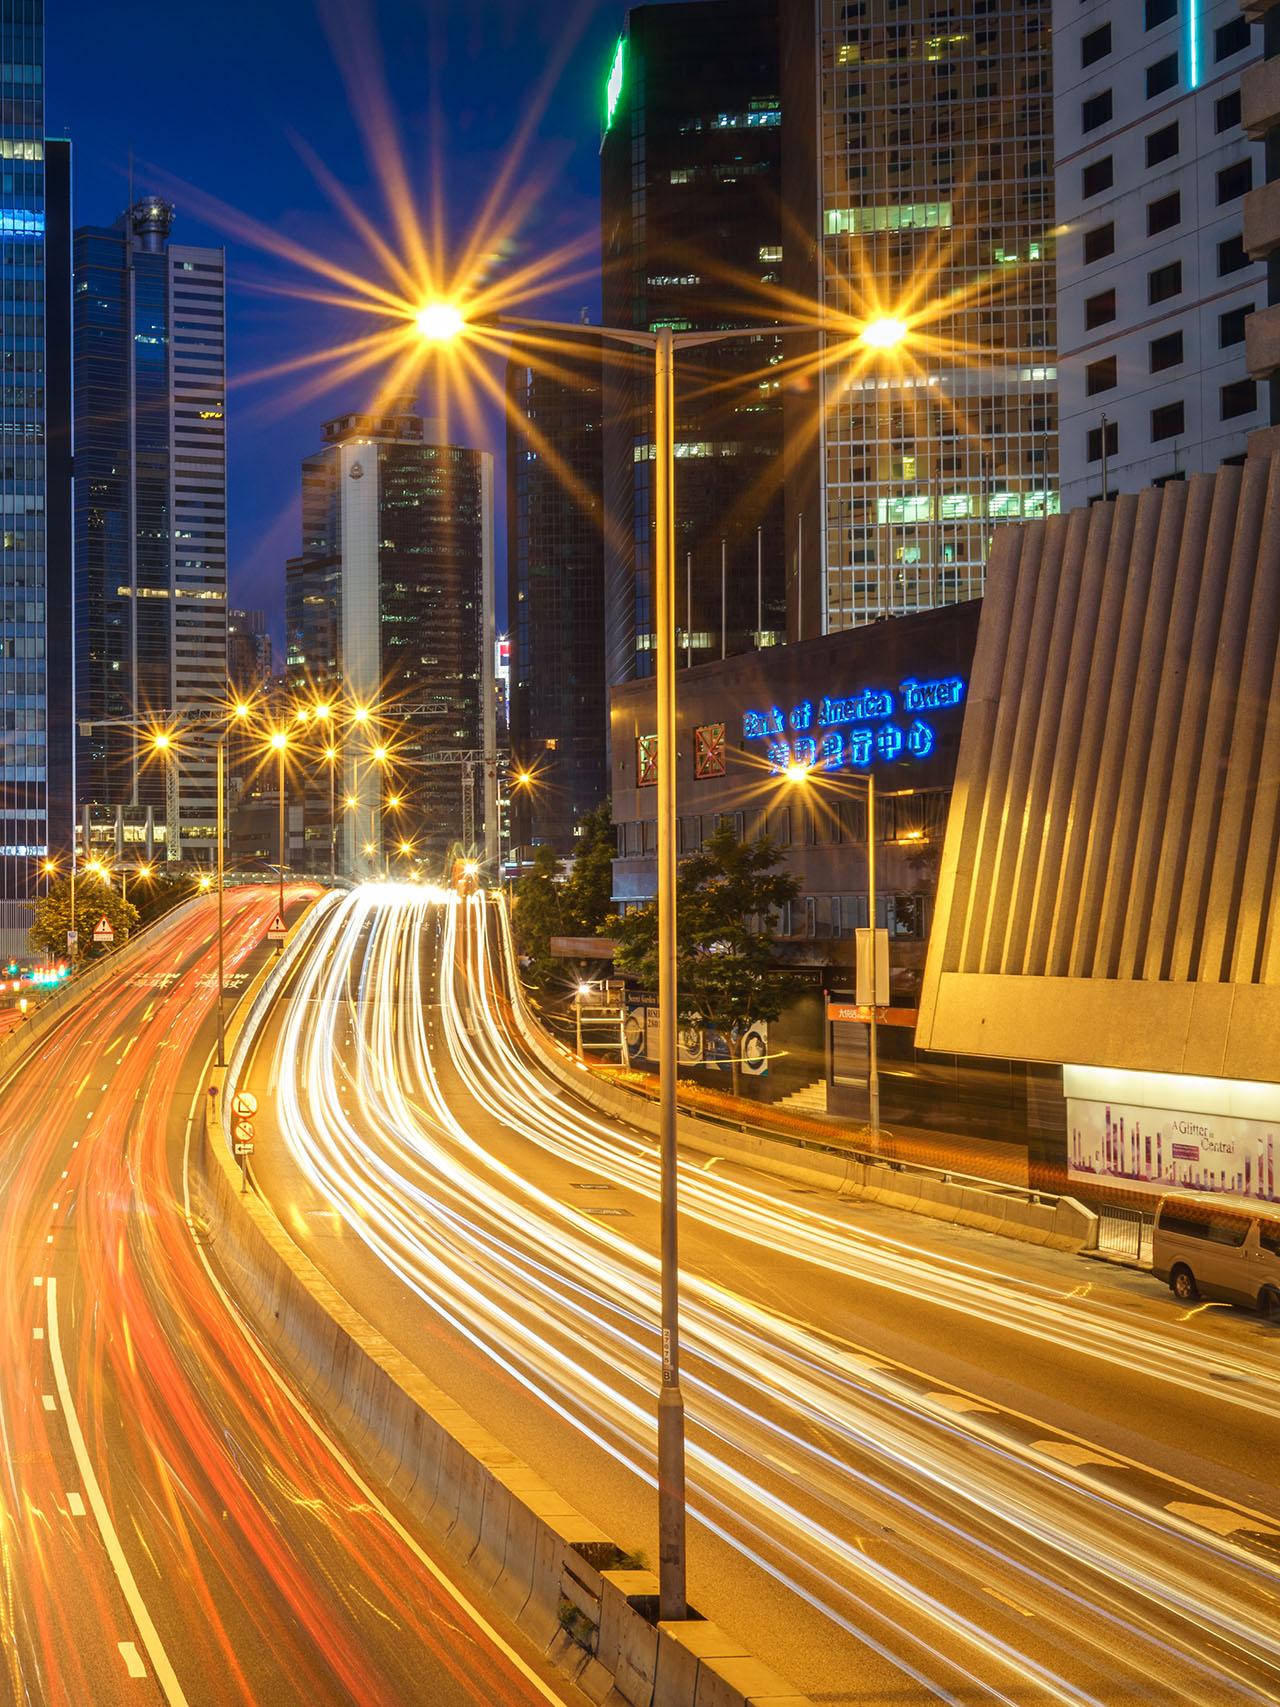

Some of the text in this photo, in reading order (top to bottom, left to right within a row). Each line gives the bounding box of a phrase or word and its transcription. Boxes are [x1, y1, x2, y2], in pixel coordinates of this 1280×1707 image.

[742, 679, 963, 738] Bank of America Tower
[1179, 1120, 1209, 1137] Glitter
[1200, 1137, 1235, 1154] Central
